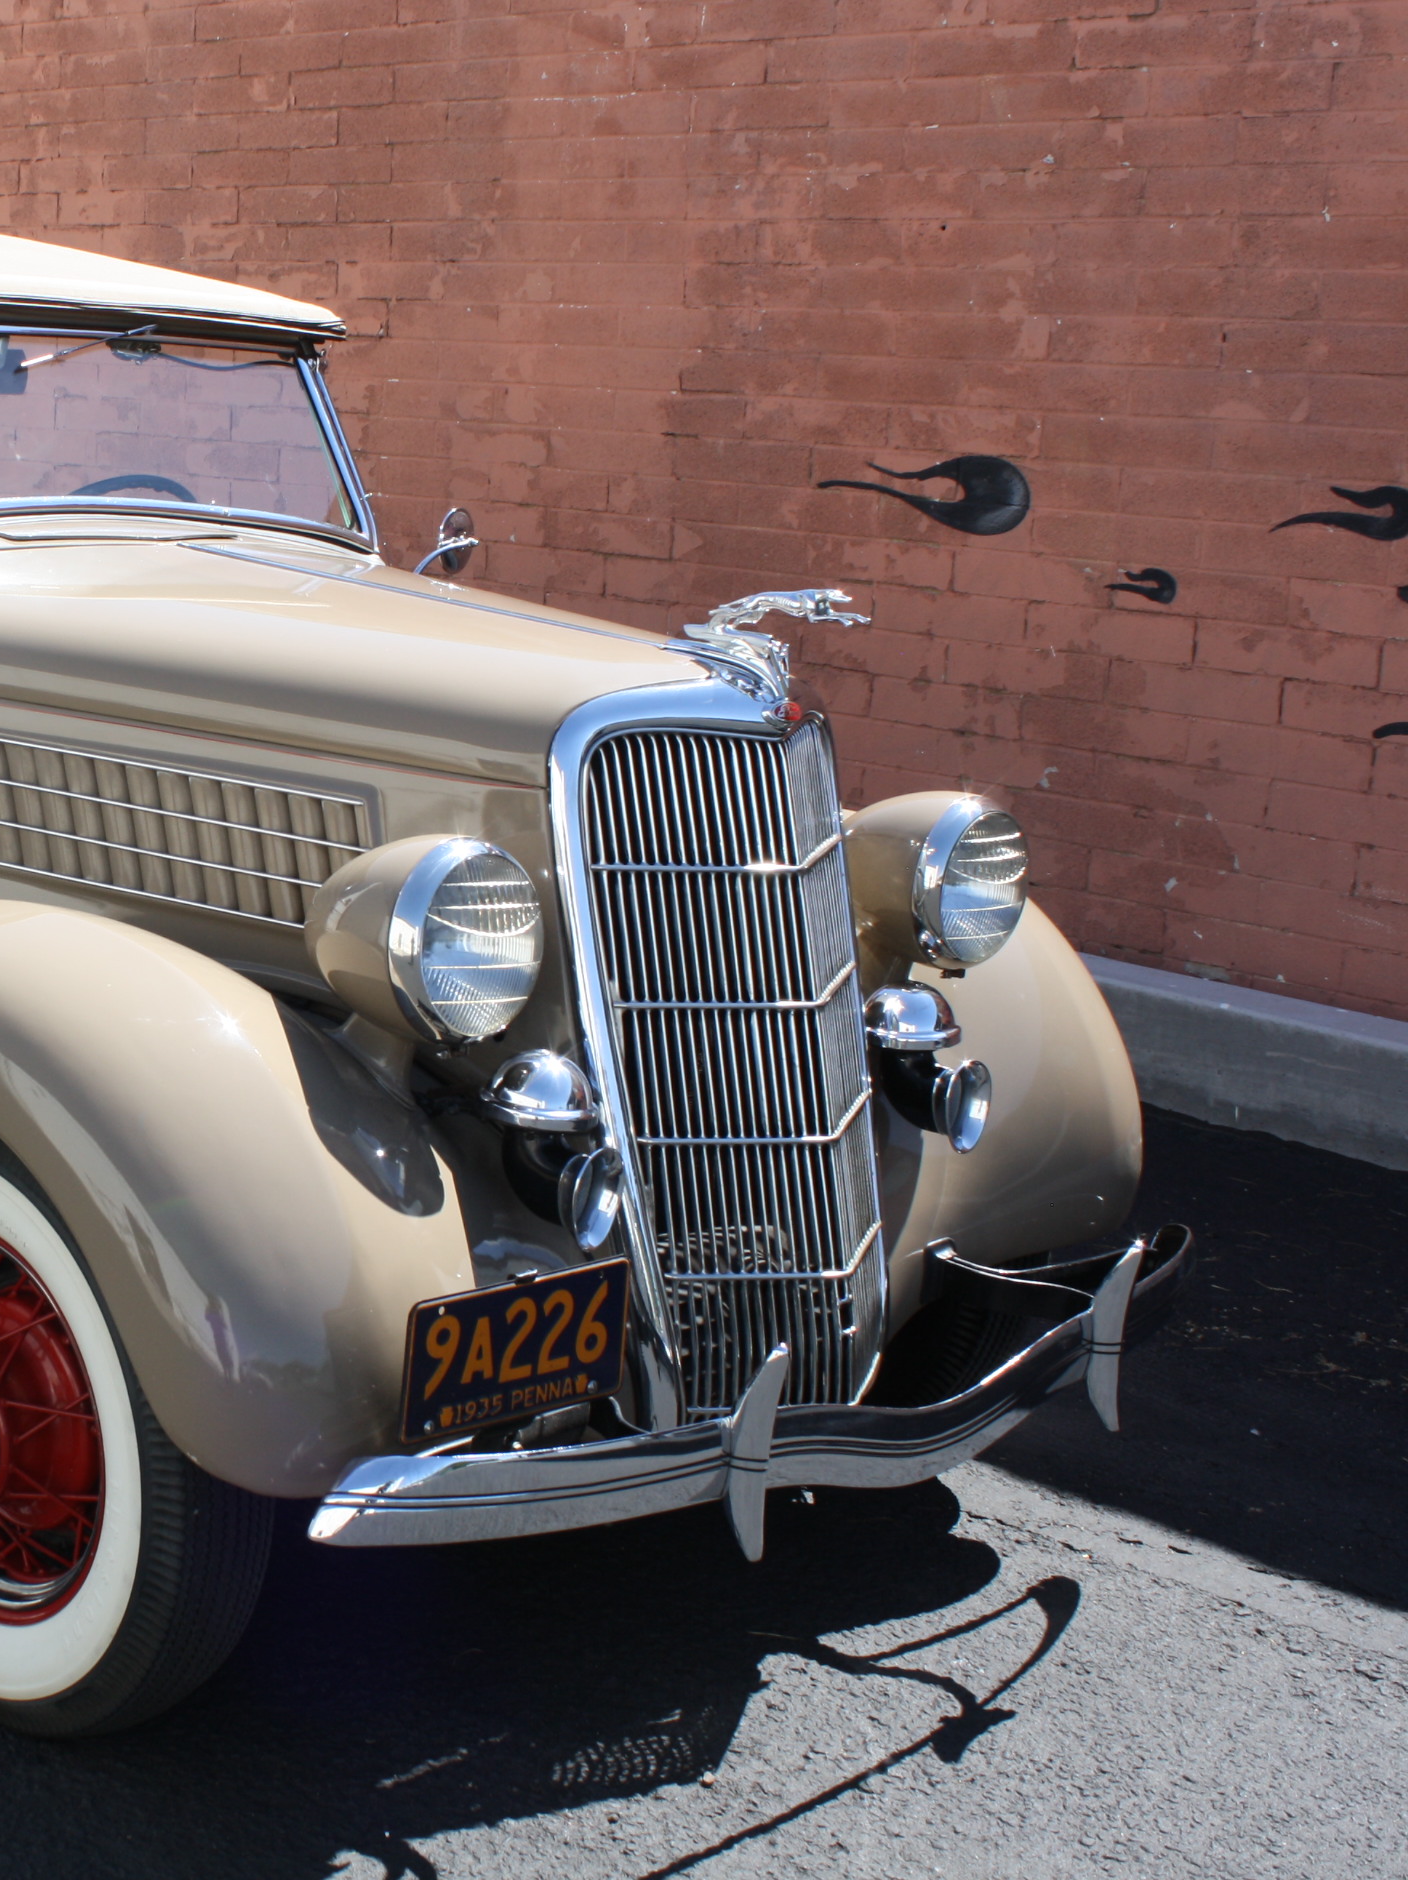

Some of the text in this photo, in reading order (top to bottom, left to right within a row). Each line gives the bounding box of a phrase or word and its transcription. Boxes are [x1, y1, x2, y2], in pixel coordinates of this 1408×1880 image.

[424, 1280, 609, 1401] 9A226
[455, 1376, 573, 1424] 1935 PENNA
